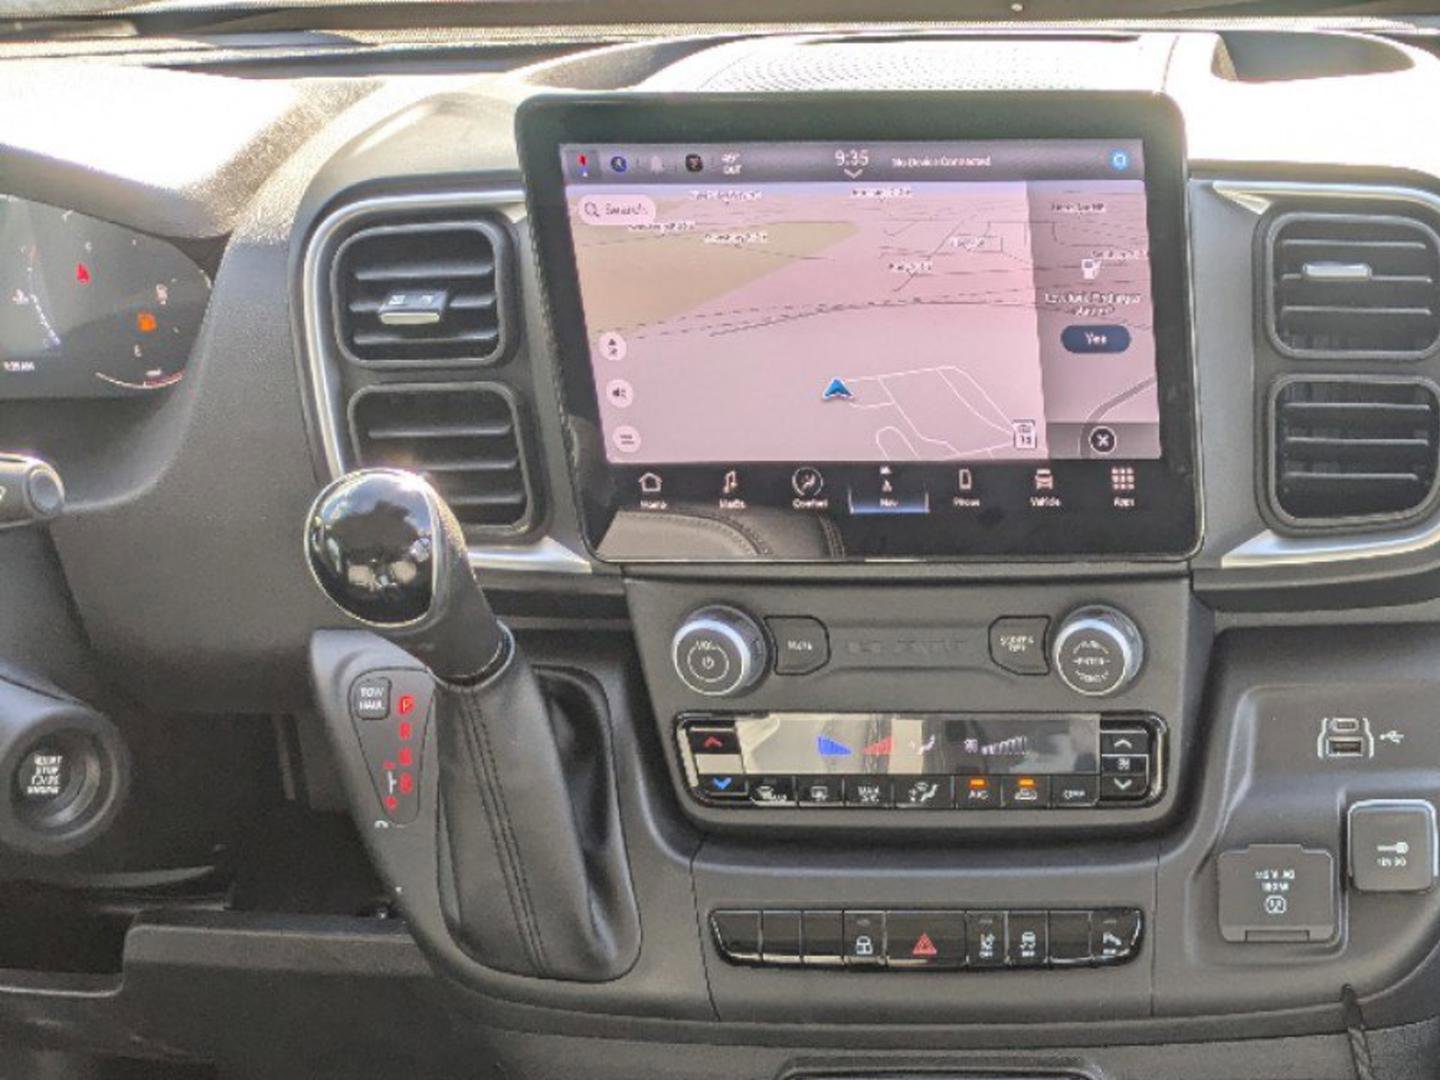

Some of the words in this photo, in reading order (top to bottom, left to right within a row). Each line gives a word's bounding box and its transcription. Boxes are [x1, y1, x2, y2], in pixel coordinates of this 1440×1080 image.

[834, 149, 869, 166] 9:35
[1084, 332, 1107, 345] Yes
[361, 687, 383, 698] TOW
